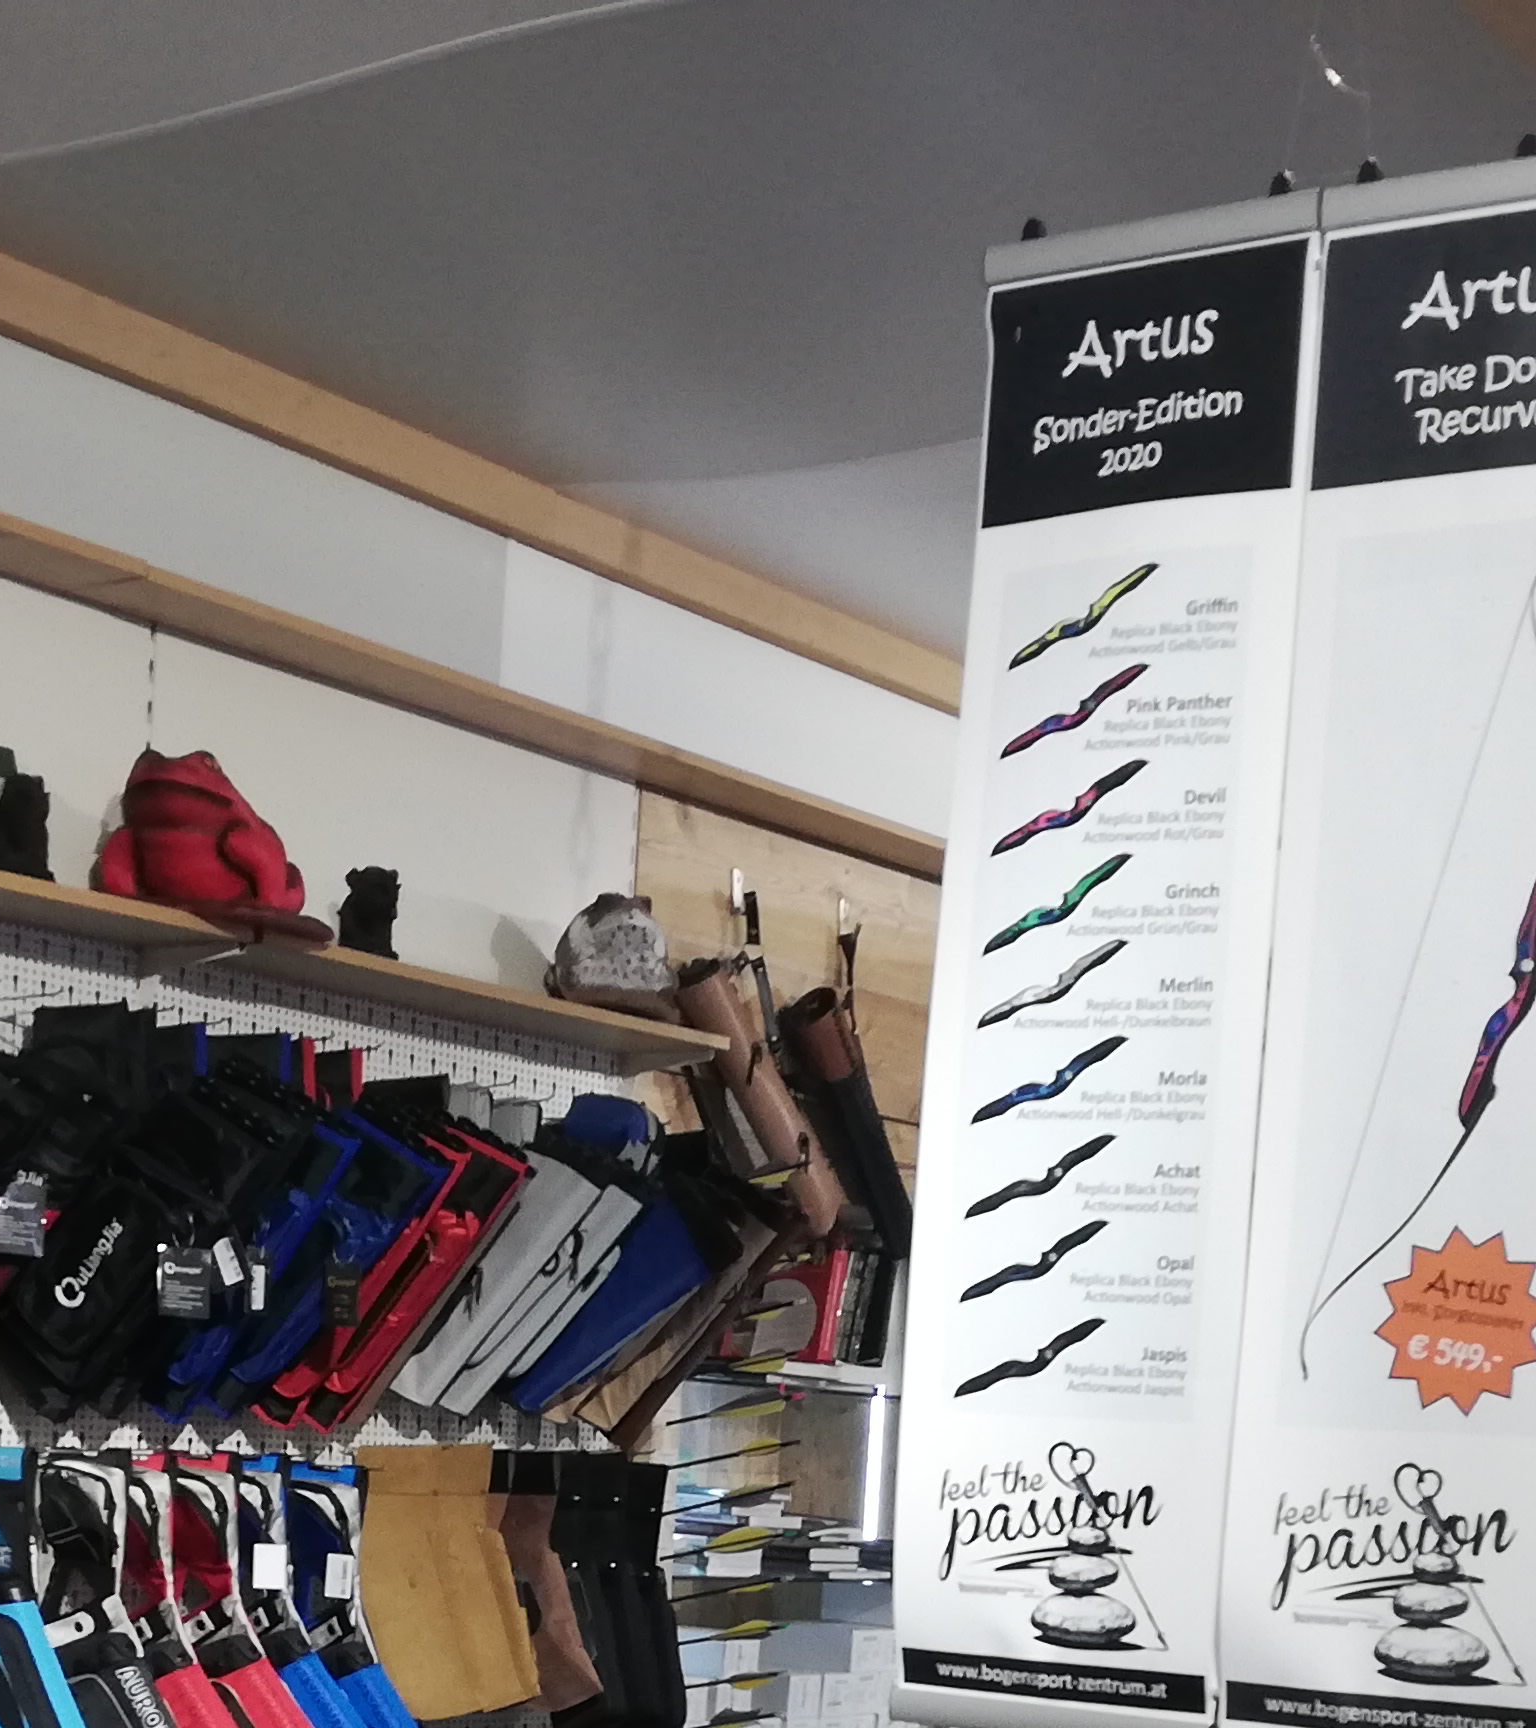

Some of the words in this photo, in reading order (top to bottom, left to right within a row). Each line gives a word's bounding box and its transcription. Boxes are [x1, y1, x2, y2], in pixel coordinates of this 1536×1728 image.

[1062, 309, 1219, 379] Artus
[1395, 361, 1477, 404] Take
[1033, 389, 1243, 453] Sonder-Edition
[1097, 441, 1163, 478] 2020
[1186, 598, 1239, 616] Griffin
[1127, 697, 1161, 714] Pink
[1167, 694, 1233, 711] Panther
[1184, 787, 1227, 805] Devil
[1165, 883, 1219, 899] Grinch
[1159, 976, 1213, 992] Merlin
[1154, 1163, 1200, 1178] Achat
[1157, 1255, 1195, 1273] Opal
[1423, 1269, 1512, 1306] Artus
[1407, 1334, 1430, 1360] €
[939, 1465, 991, 1510] feel
[991, 1461, 1047, 1495] the
[1274, 1488, 1332, 1534] feel
[1333, 1484, 1392, 1519] the
[936, 1662, 1167, 1700] www.bogensport-zentrum.at
